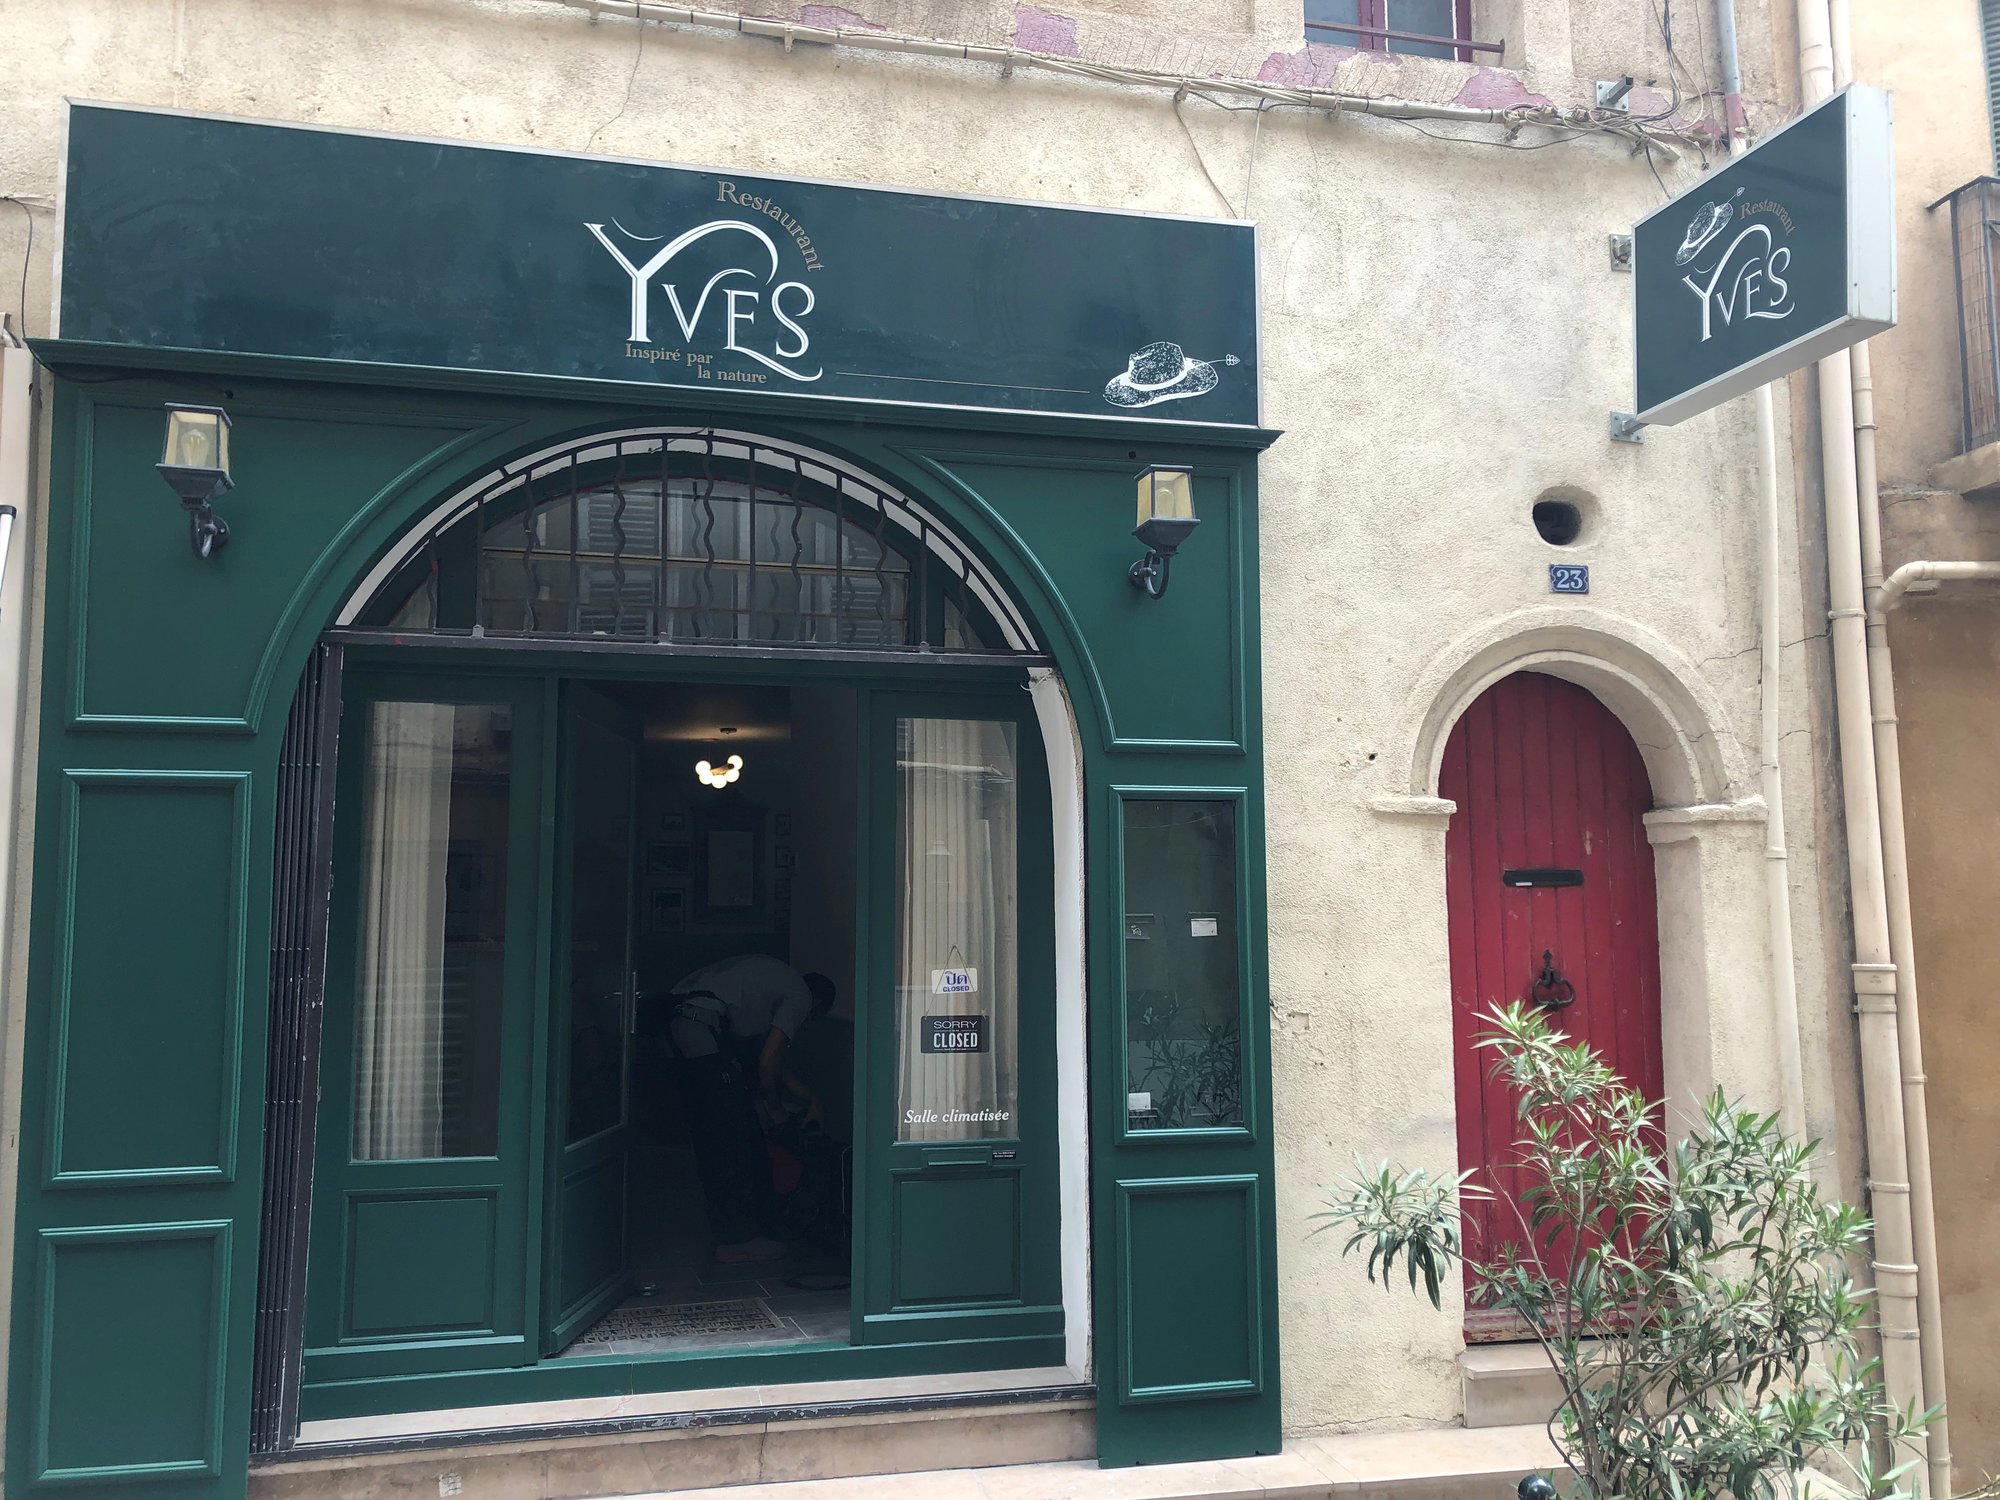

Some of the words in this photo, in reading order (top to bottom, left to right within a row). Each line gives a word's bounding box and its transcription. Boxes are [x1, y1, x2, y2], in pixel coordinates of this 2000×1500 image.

[716, 180, 825, 273] Restaurant
[1740, 199, 1797, 236] Restaurant
[1681, 223, 1796, 342] YVES
[583, 216, 823, 382] YVES
[625, 343, 681, 363] Inspiré
[686, 352, 713, 367] par
[697, 364, 711, 380] la
[717, 368, 767, 383] nature
[1556, 569, 1583, 589] 23
[944, 970, 969, 985] ปิด
[942, 985, 970, 993] CLOSED
[933, 1020, 978, 1029] SORRY
[933, 1032, 978, 1048] CLOSED
[904, 1109, 938, 1124] Salle
[942, 1109, 1010, 1123] climatisée
